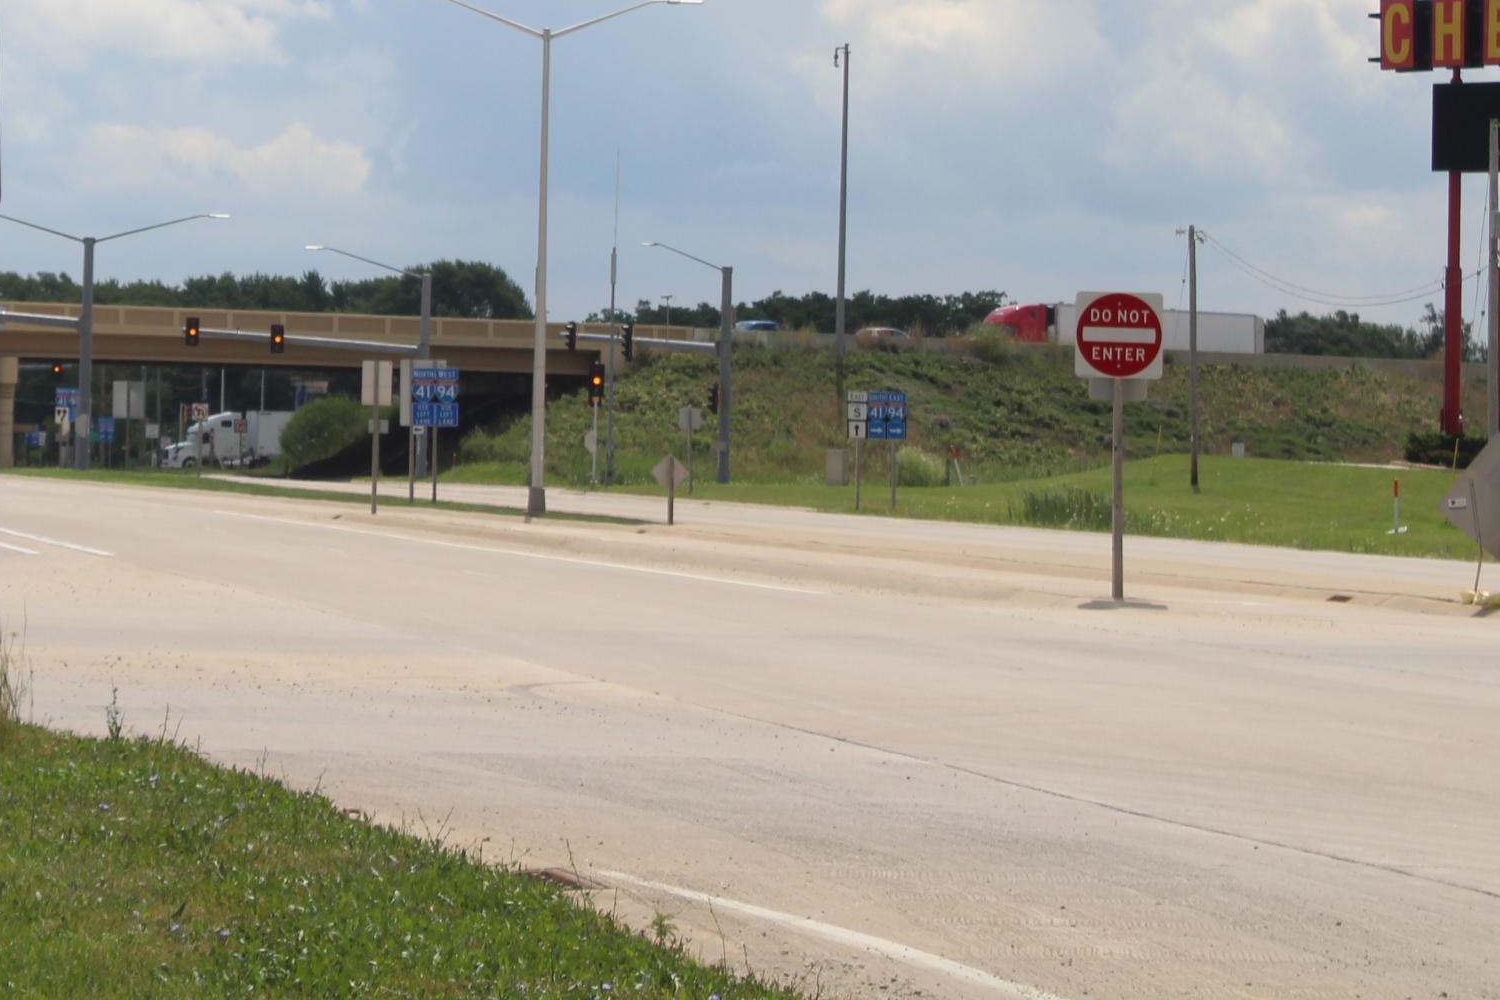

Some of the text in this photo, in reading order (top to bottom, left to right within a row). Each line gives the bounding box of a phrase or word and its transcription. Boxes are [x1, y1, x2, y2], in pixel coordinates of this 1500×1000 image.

[1090, 308, 1150, 324] DO NOT
[1092, 346, 1146, 362] ENTER
[416, 385, 431, 399] 41
[437, 385, 455, 399] 94
[853, 407, 861, 418] S
[870, 407, 882, 417] 41
[888, 407, 903, 417] 94
